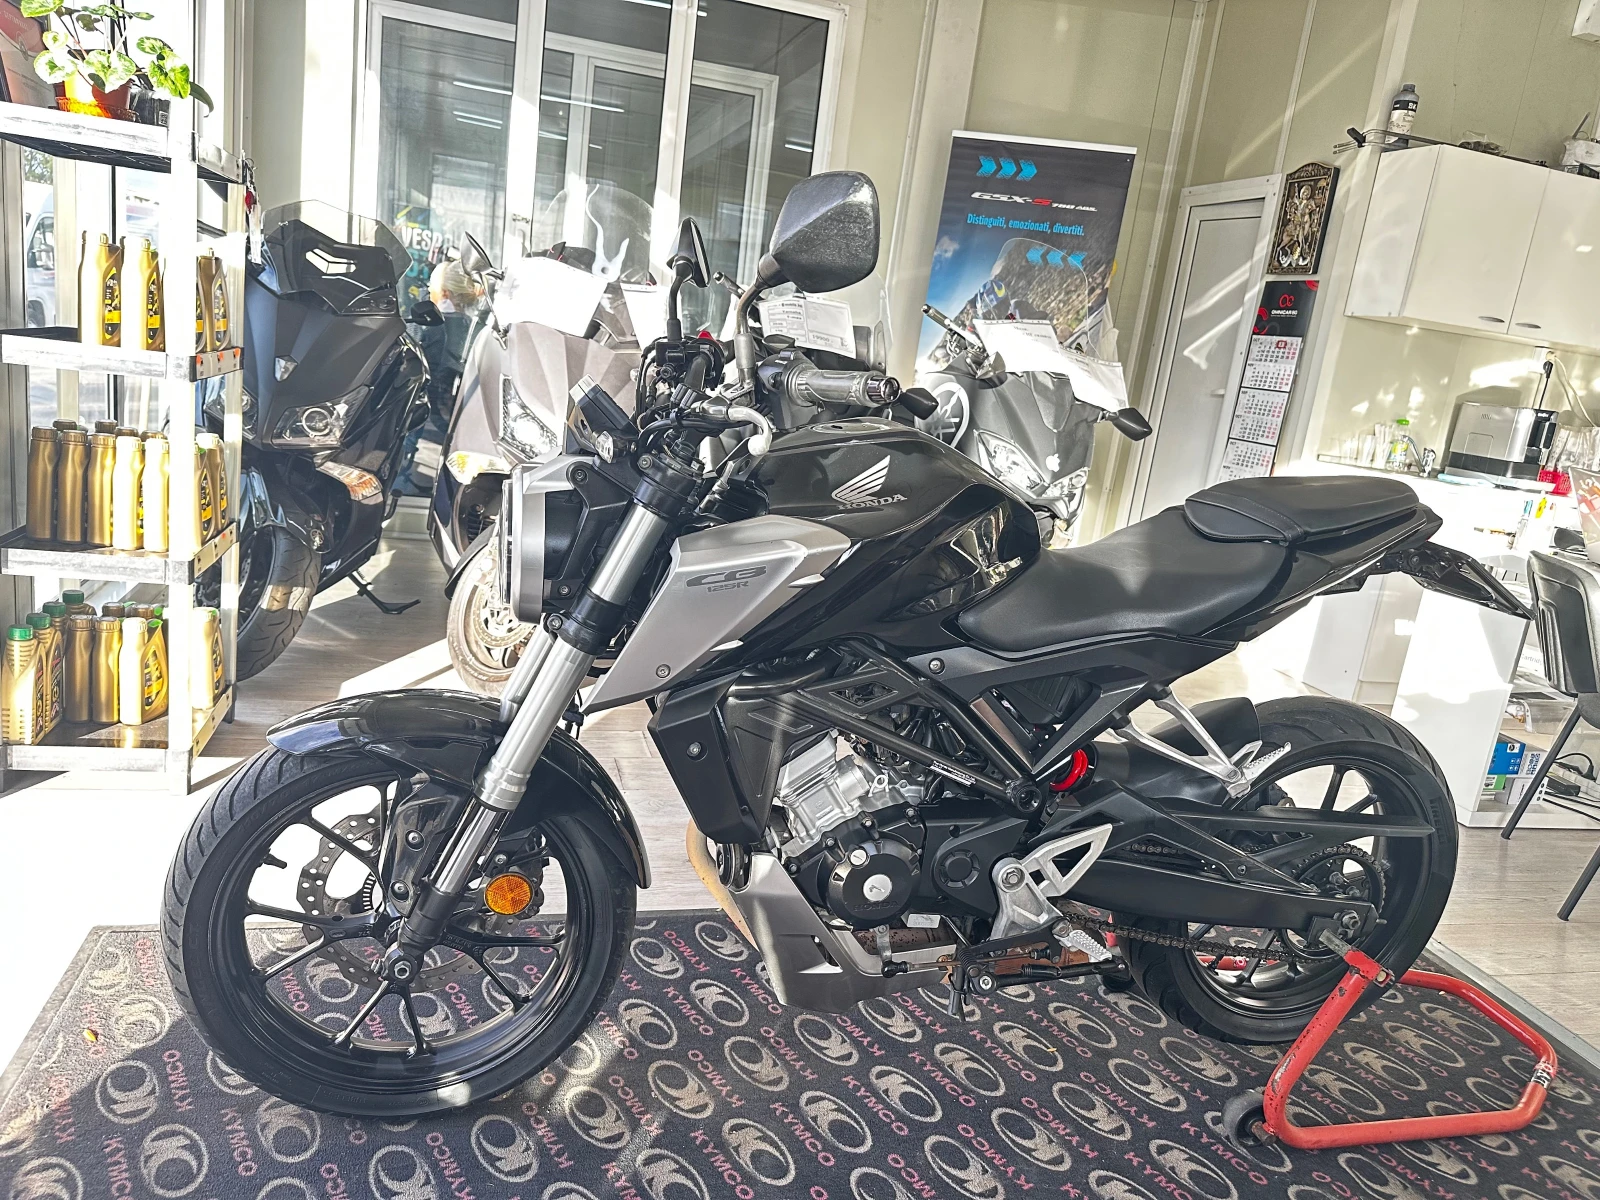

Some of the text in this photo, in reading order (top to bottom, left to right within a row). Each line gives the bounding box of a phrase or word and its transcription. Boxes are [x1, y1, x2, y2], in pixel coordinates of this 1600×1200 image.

[966, 213, 1085, 236] Distinguiti, emozionati, divertiti.
[836, 493, 908, 511] HONDA
[686, 565, 767, 588] CB
[706, 580, 750, 593] 125R
[664, 930, 711, 973] KYMCO
[280, 967, 311, 1012] YMCO
[663, 986, 714, 1036] KYMCO
[731, 967, 783, 1015] KYMCO
[1077, 991, 1145, 1038] KYMCO
[760, 1026, 819, 1081] KYMCO
[969, 1029, 1037, 1082] KYMCO
[1026, 1009, 1093, 1058] KYMCO
[1182, 1027, 1259, 1077] KYMCO
[1366, 1029, 1449, 1078] KYMCO
[1403, 1009, 1486, 1056] KYMCO
[163, 1050, 195, 1112] KYMCO
[688, 1049, 744, 1108] KYMCO
[908, 1050, 977, 1107] KYMCO
[1079, 1071, 1157, 1128] KYMCO
[1133, 1048, 1210, 1102] KYMCO
[1326, 1051, 1409, 1101] KYMCO
[608, 1075, 664, 1137] KYMCO
[841, 1075, 909, 1137] KYMCO
[1021, 1096, 1099, 1159] KYMCO
[221, 1107, 258, 1176] KYMCO
[522, 1102, 574, 1169] KYMCO
[769, 1102, 836, 1167] KYMCO
[956, 1123, 1035, 1191] KYMCO
[1181, 1120, 1269, 1186] KYMCO
[690, 1129, 755, 1200] KYMCO
